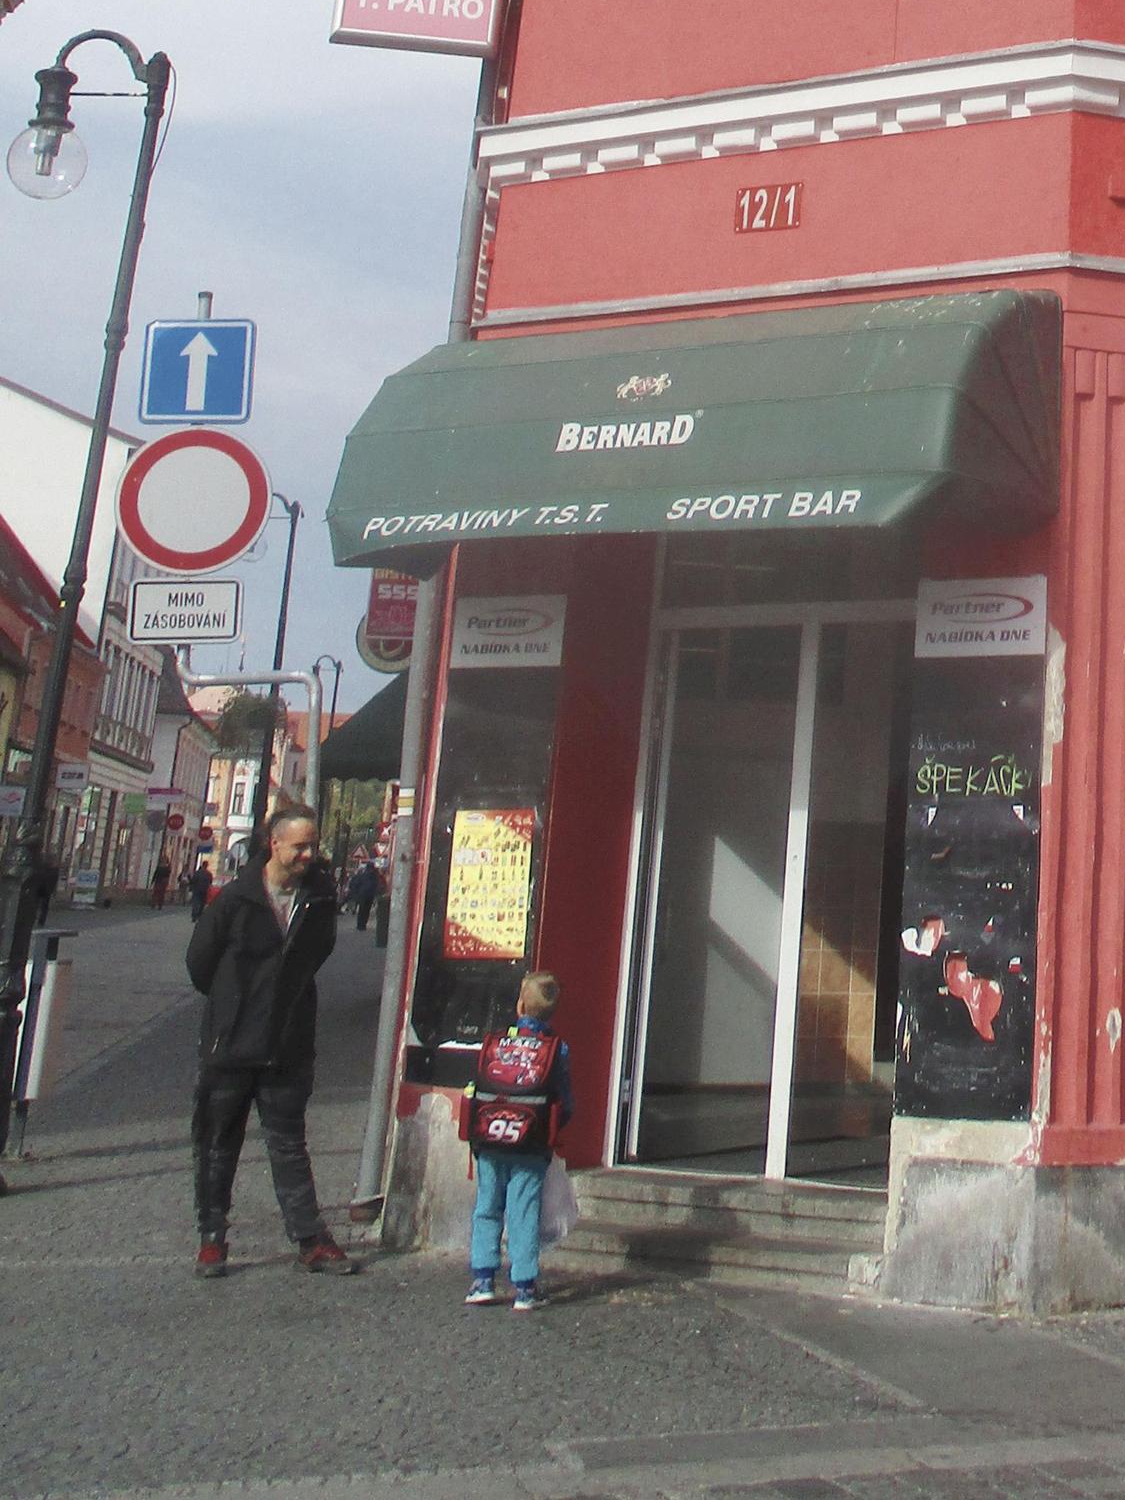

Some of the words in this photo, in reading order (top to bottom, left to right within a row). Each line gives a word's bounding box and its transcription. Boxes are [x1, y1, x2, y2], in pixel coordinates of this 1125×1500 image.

[740, 185, 796, 229] 12/1
[555, 414, 694, 452] BERNARD
[666, 492, 782, 522] SPORT
[788, 488, 862, 518] BAR
[363, 506, 531, 540] POTRAVINY
[534, 503, 610, 526] T.S.T.
[168, 591, 205, 609] MIMO
[931, 597, 1006, 618] Partner
[143, 609, 228, 630] ZÁSOBOVÁNÍ
[466, 614, 531, 631] Partner
[924, 627, 995, 645] NABÍDKA
[999, 627, 1031, 643] DNE
[459, 640, 521, 656] NABÍDKA
[523, 639, 552, 654] DNE
[488, 1119, 523, 1143] 95
